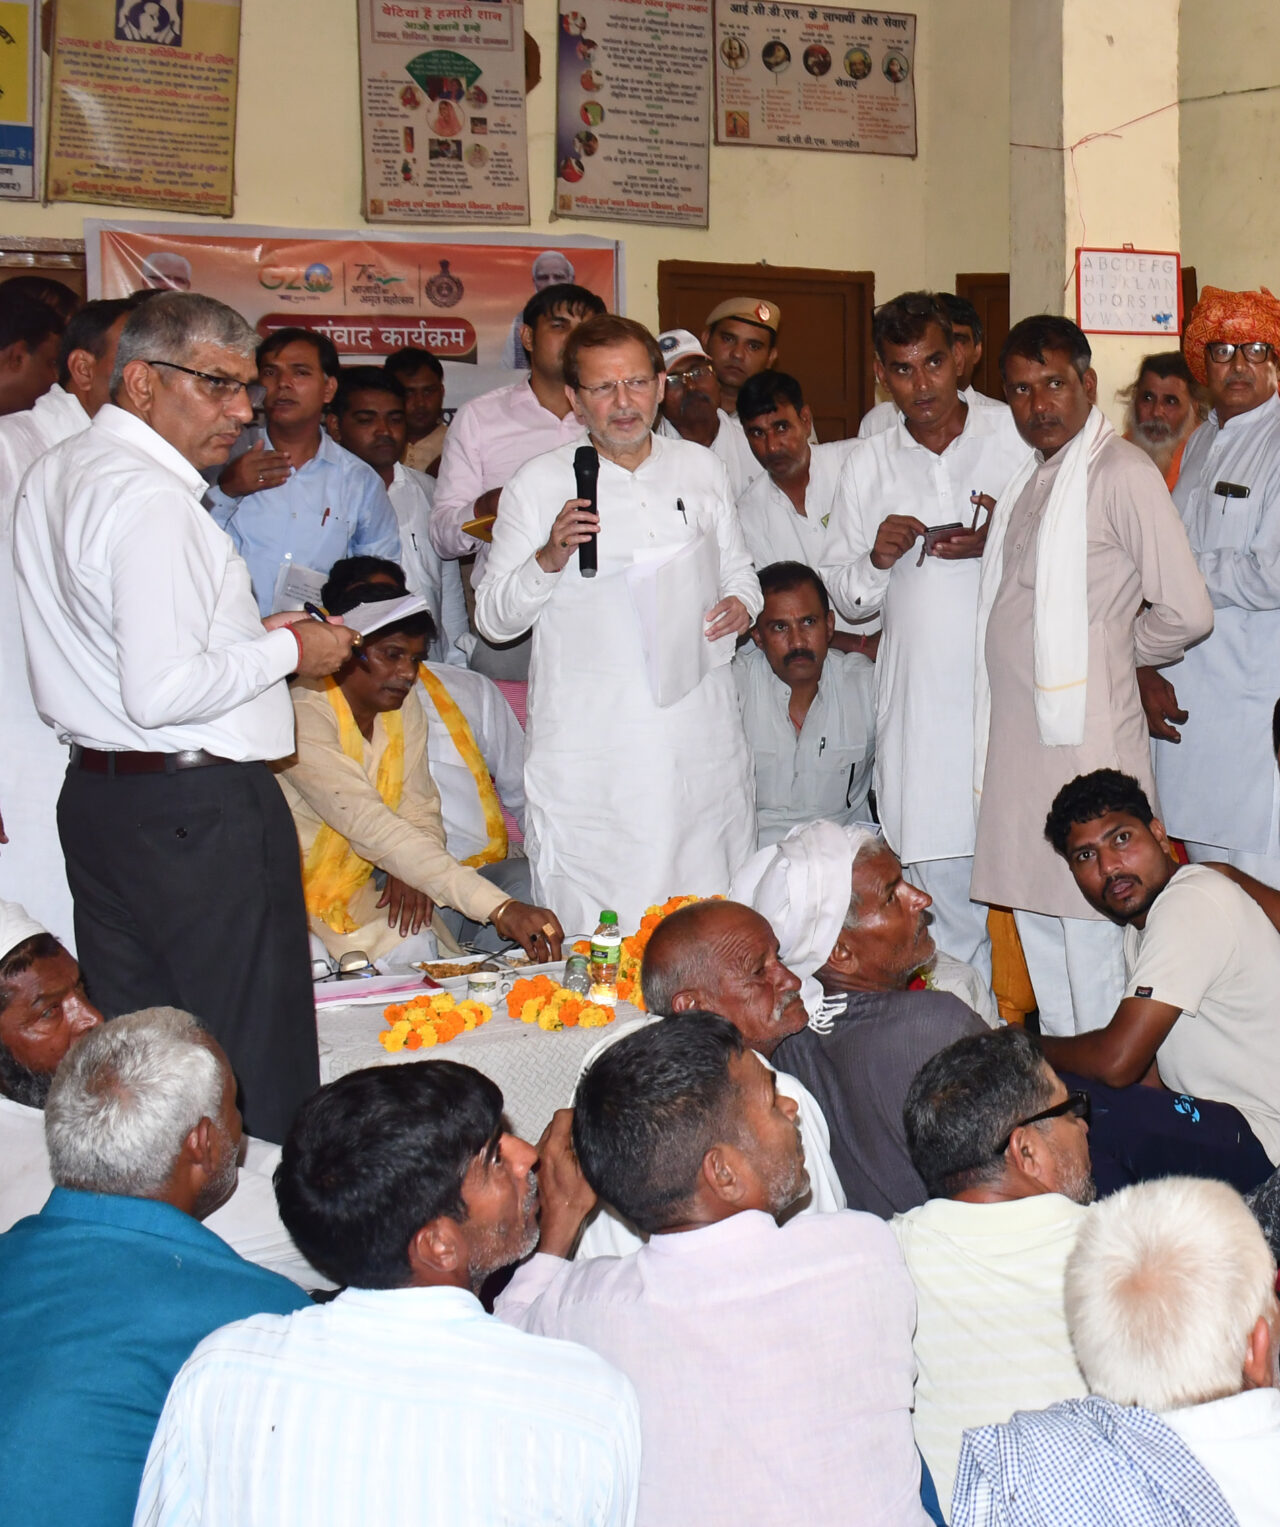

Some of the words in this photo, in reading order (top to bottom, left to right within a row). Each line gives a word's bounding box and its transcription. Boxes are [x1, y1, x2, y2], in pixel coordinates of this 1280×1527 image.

[436, 4, 472, 20] हमारी
[477, 10, 502, 22] शान
[861, 13, 879, 26] और
[378, 320, 466, 347] कार्यक्रम
